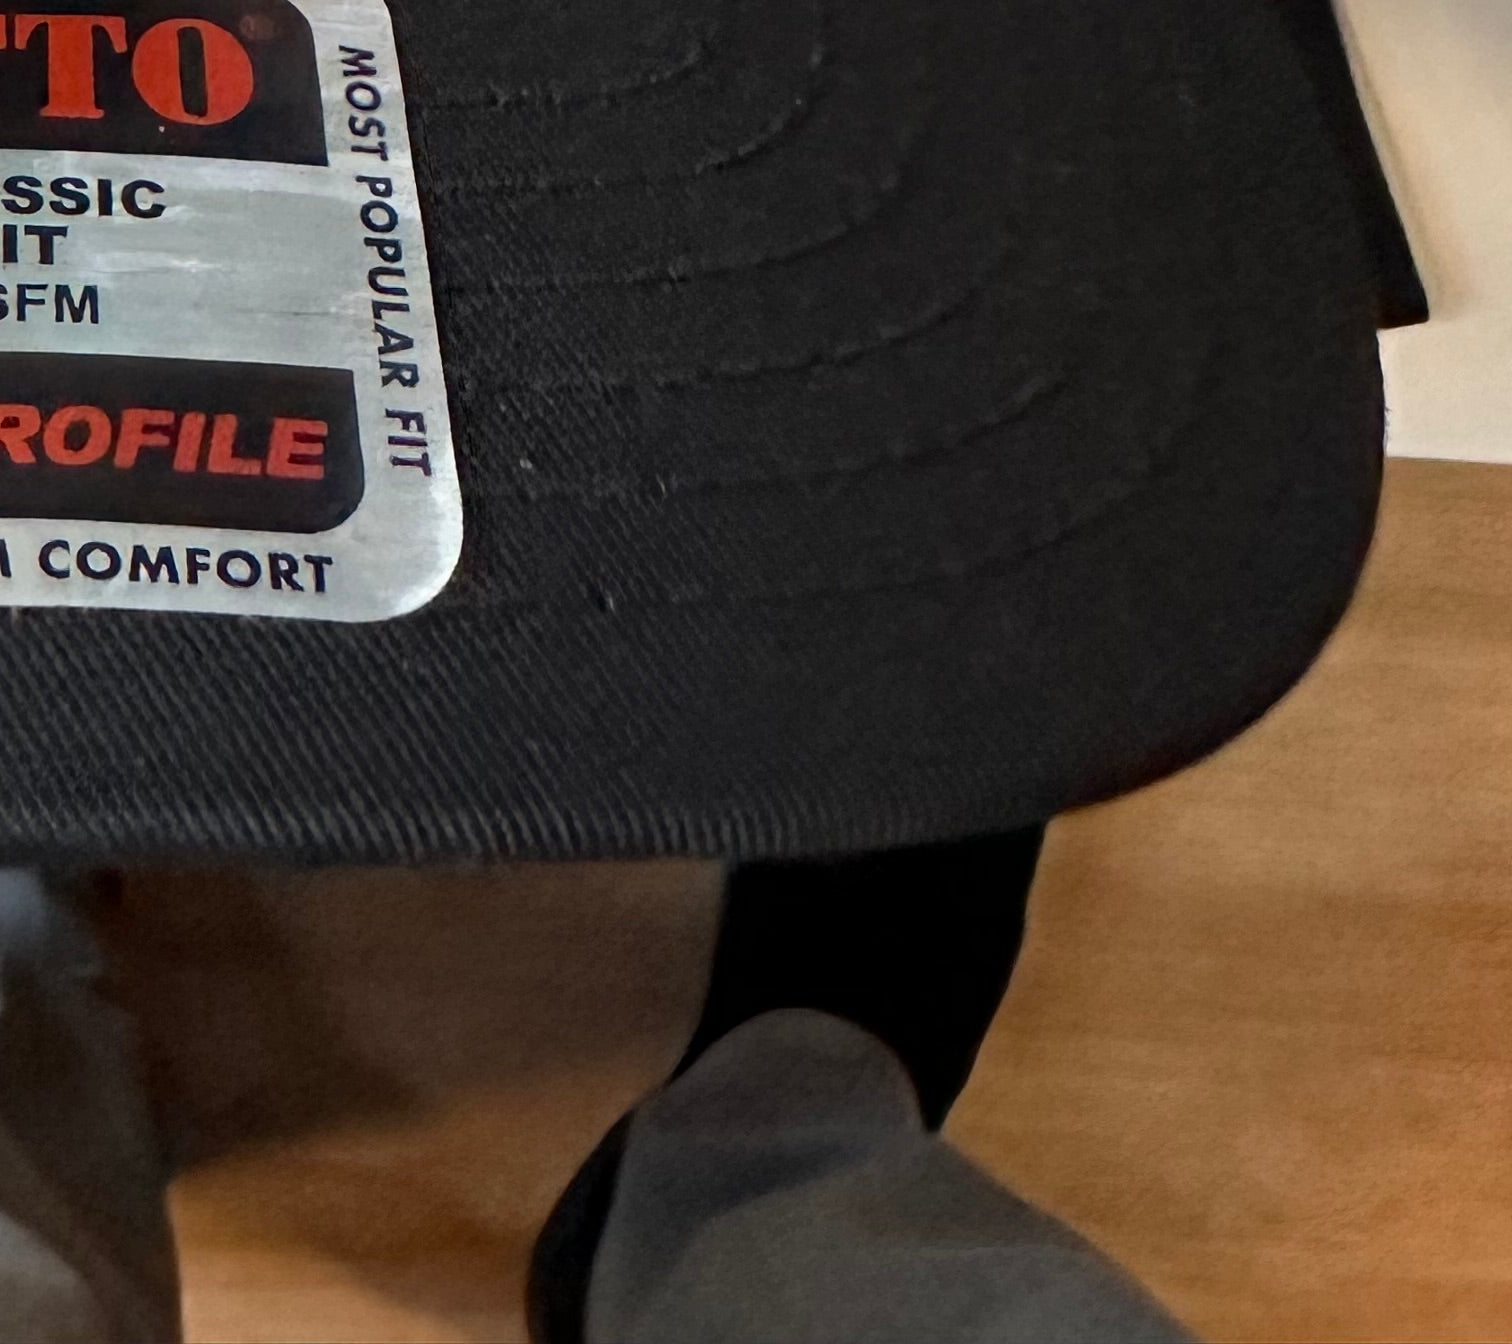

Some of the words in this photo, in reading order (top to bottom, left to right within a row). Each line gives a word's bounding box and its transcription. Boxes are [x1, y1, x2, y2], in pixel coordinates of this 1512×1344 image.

[340, 45, 387, 162] MOST
[357, 176, 419, 389] POPULAR
[386, 409, 430, 477] FIT
[38, 540, 334, 594] COMFORT
